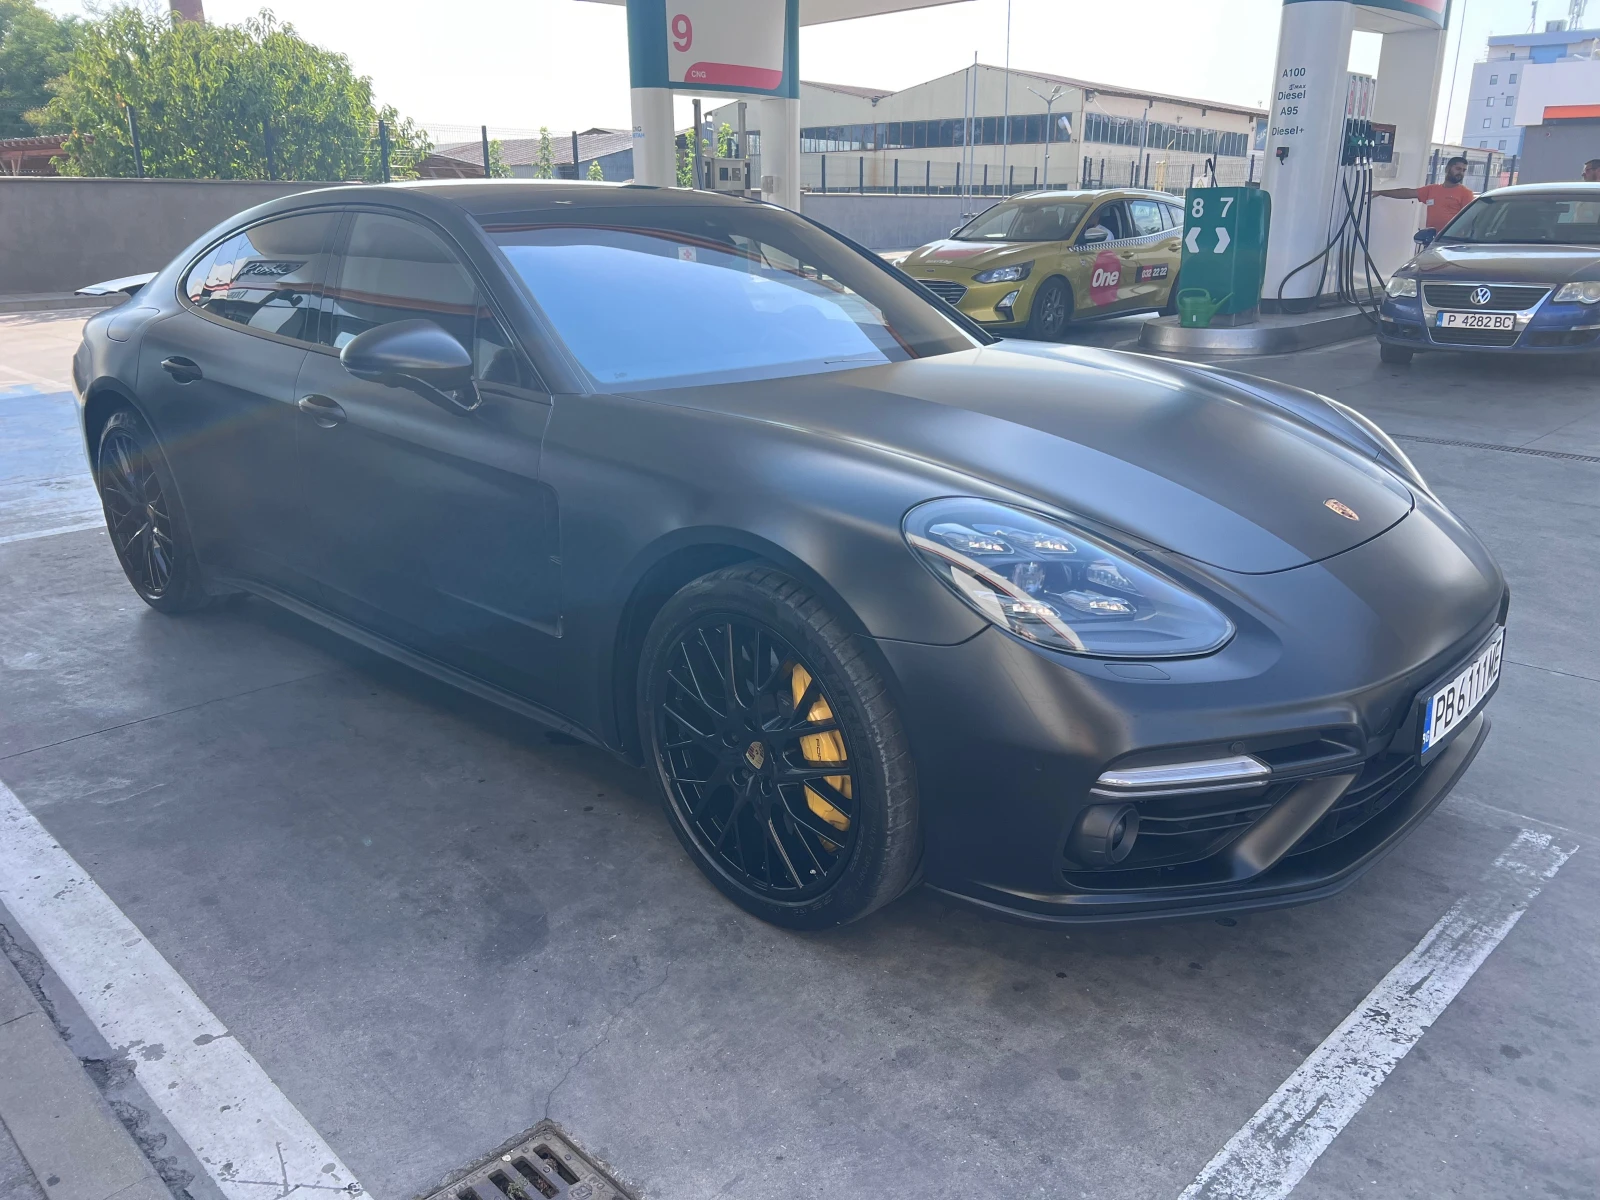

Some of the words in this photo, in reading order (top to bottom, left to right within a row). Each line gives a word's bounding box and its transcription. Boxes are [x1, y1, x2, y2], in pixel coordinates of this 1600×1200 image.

[671, 13, 693, 53] 9
[691, 70, 707, 79] CNG
[1281, 67, 1306, 78] A100
[1277, 90, 1306, 101] Diesel
[1280, 106, 1299, 116] A95
[1271, 126, 1305, 136] Diesel+
[1191, 197, 1204, 218] 8
[1220, 197, 1234, 218] 7
[1092, 268, 1119, 287] One
[1141, 269, 1152, 278] 032
[1152, 268, 1160, 277] 22
[1160, 267, 1168, 276] 22
[1448, 314, 1456, 326] P
[1462, 315, 1491, 328] 4282
[1493, 316, 1511, 329] BC
